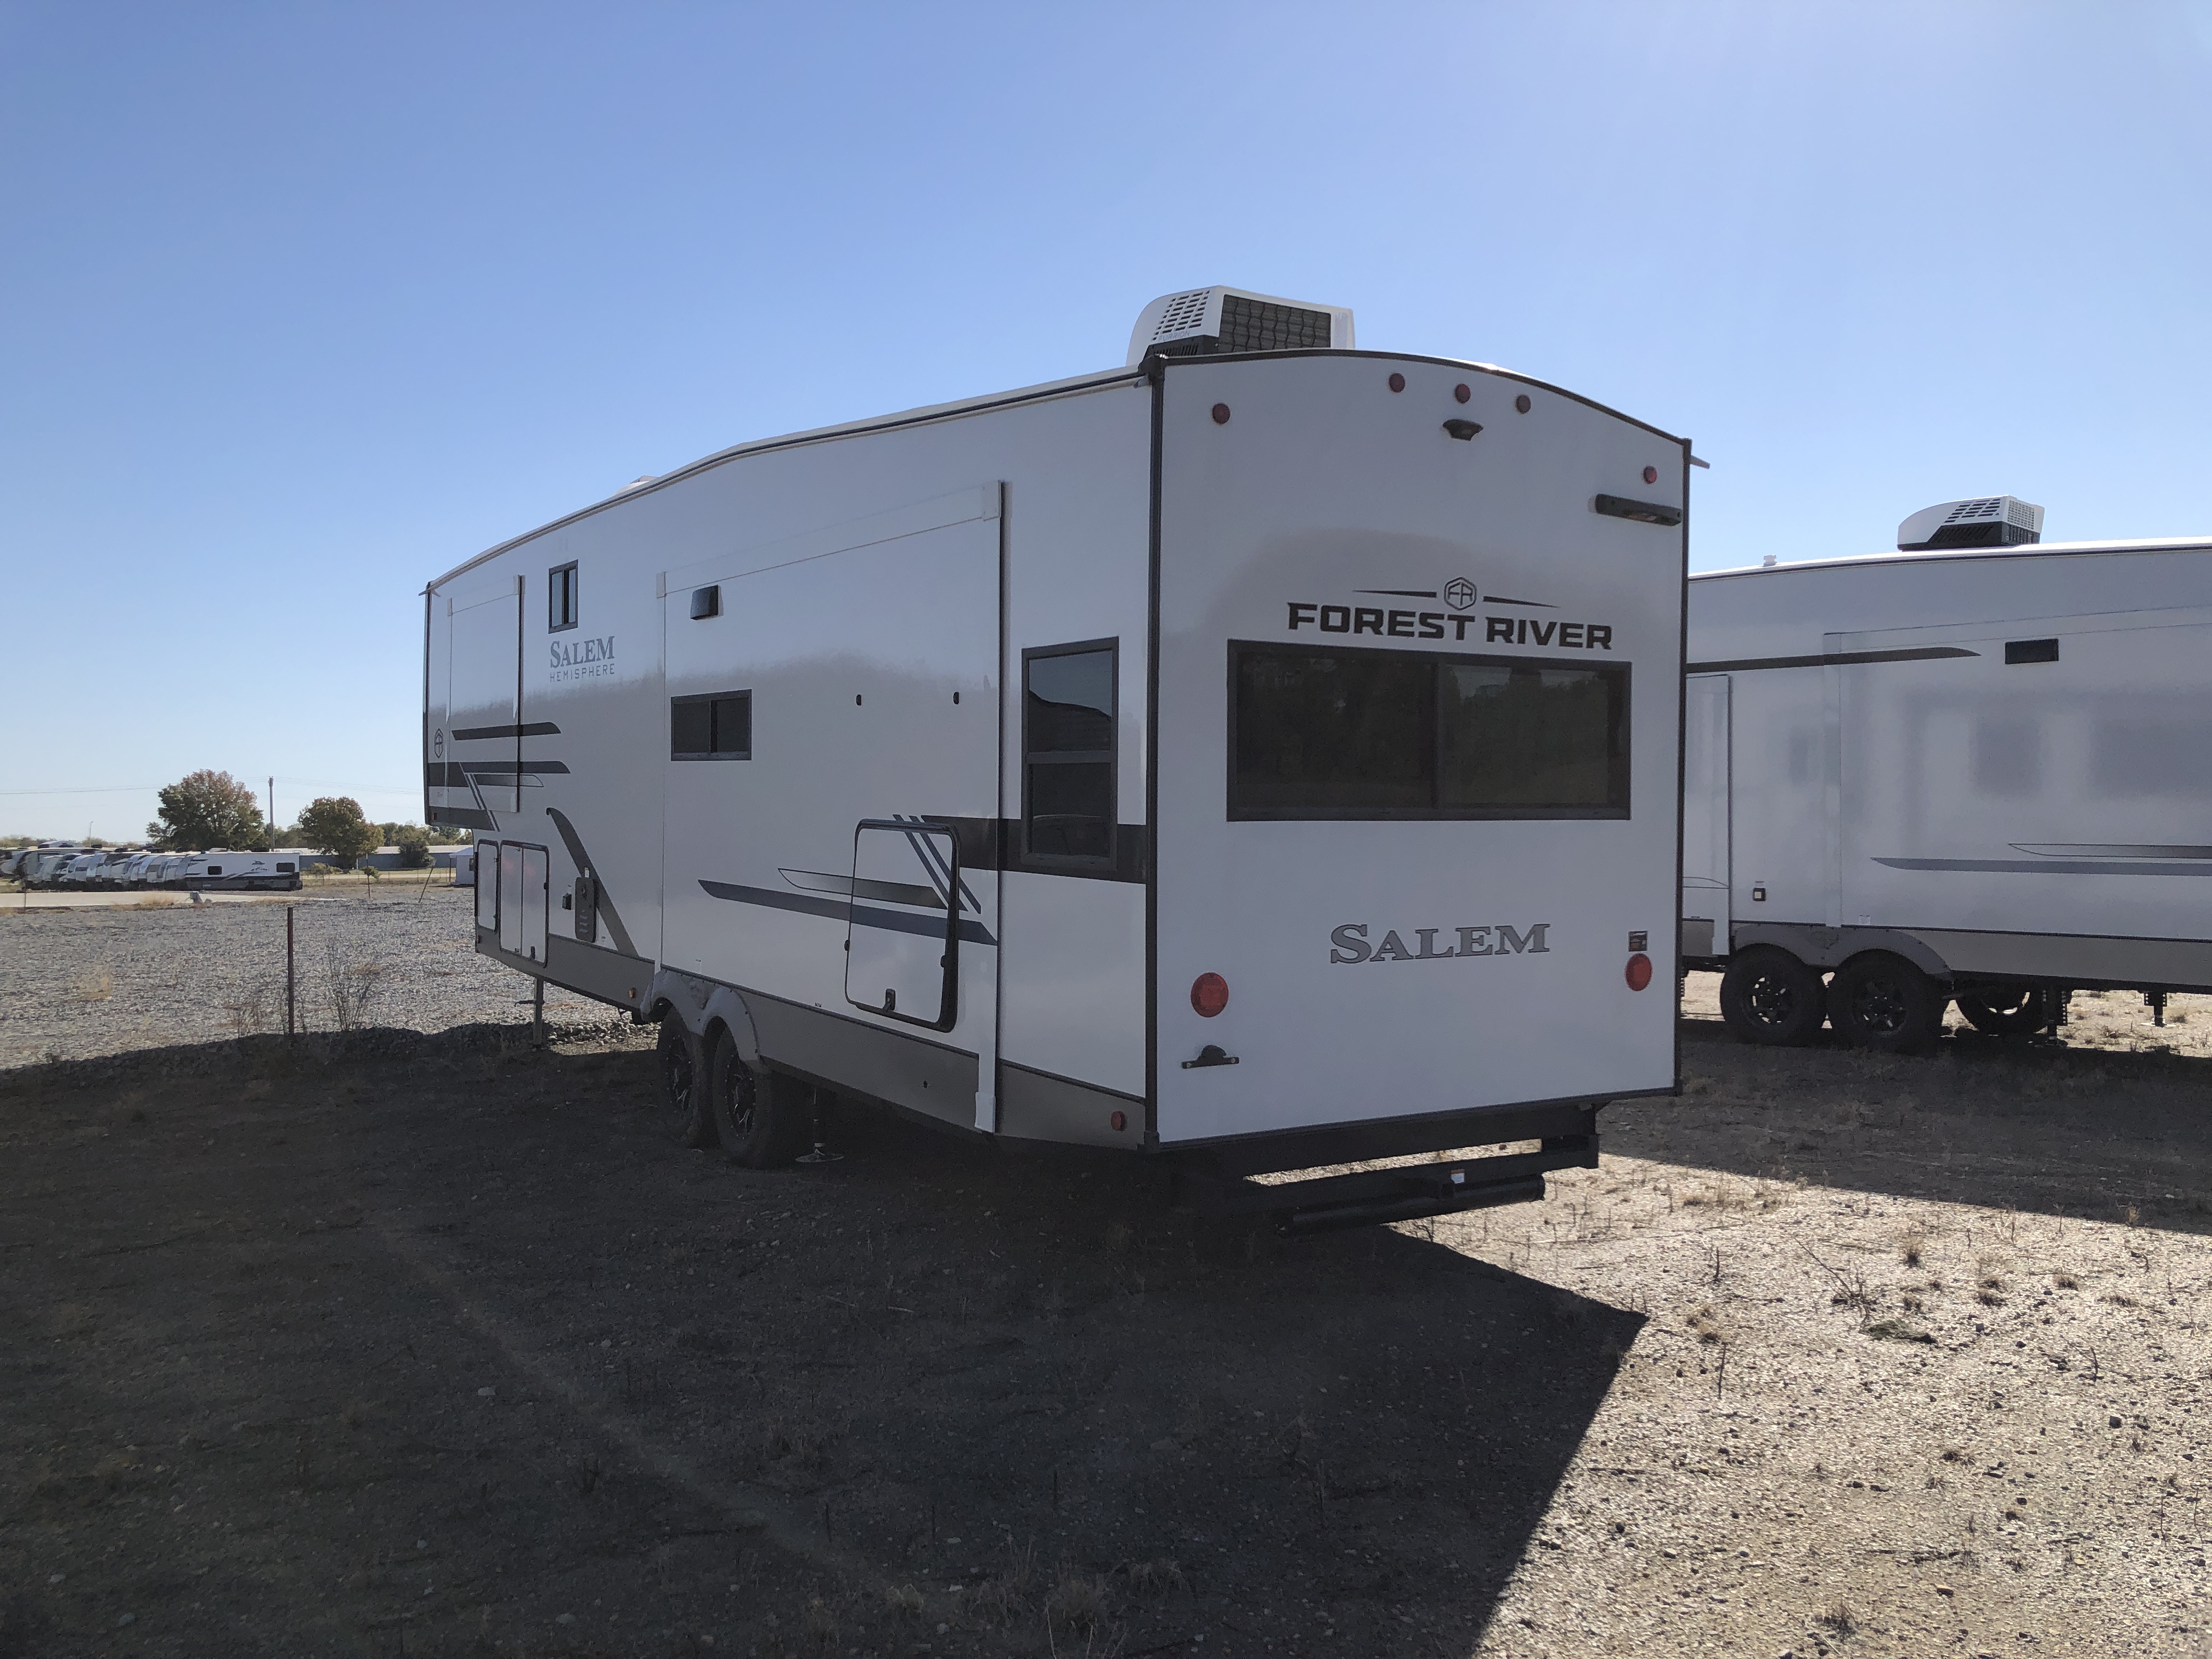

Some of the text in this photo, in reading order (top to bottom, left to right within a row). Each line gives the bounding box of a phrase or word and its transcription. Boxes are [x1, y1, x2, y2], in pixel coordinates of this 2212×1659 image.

[1158, 330, 1190, 342] FURRION
[1288, 602, 1612, 651] FOREST RIVER
[550, 636, 615, 668] SALEM
[550, 663, 615, 682] HEMISPHERE
[1330, 923, 1551, 964] SALEM
